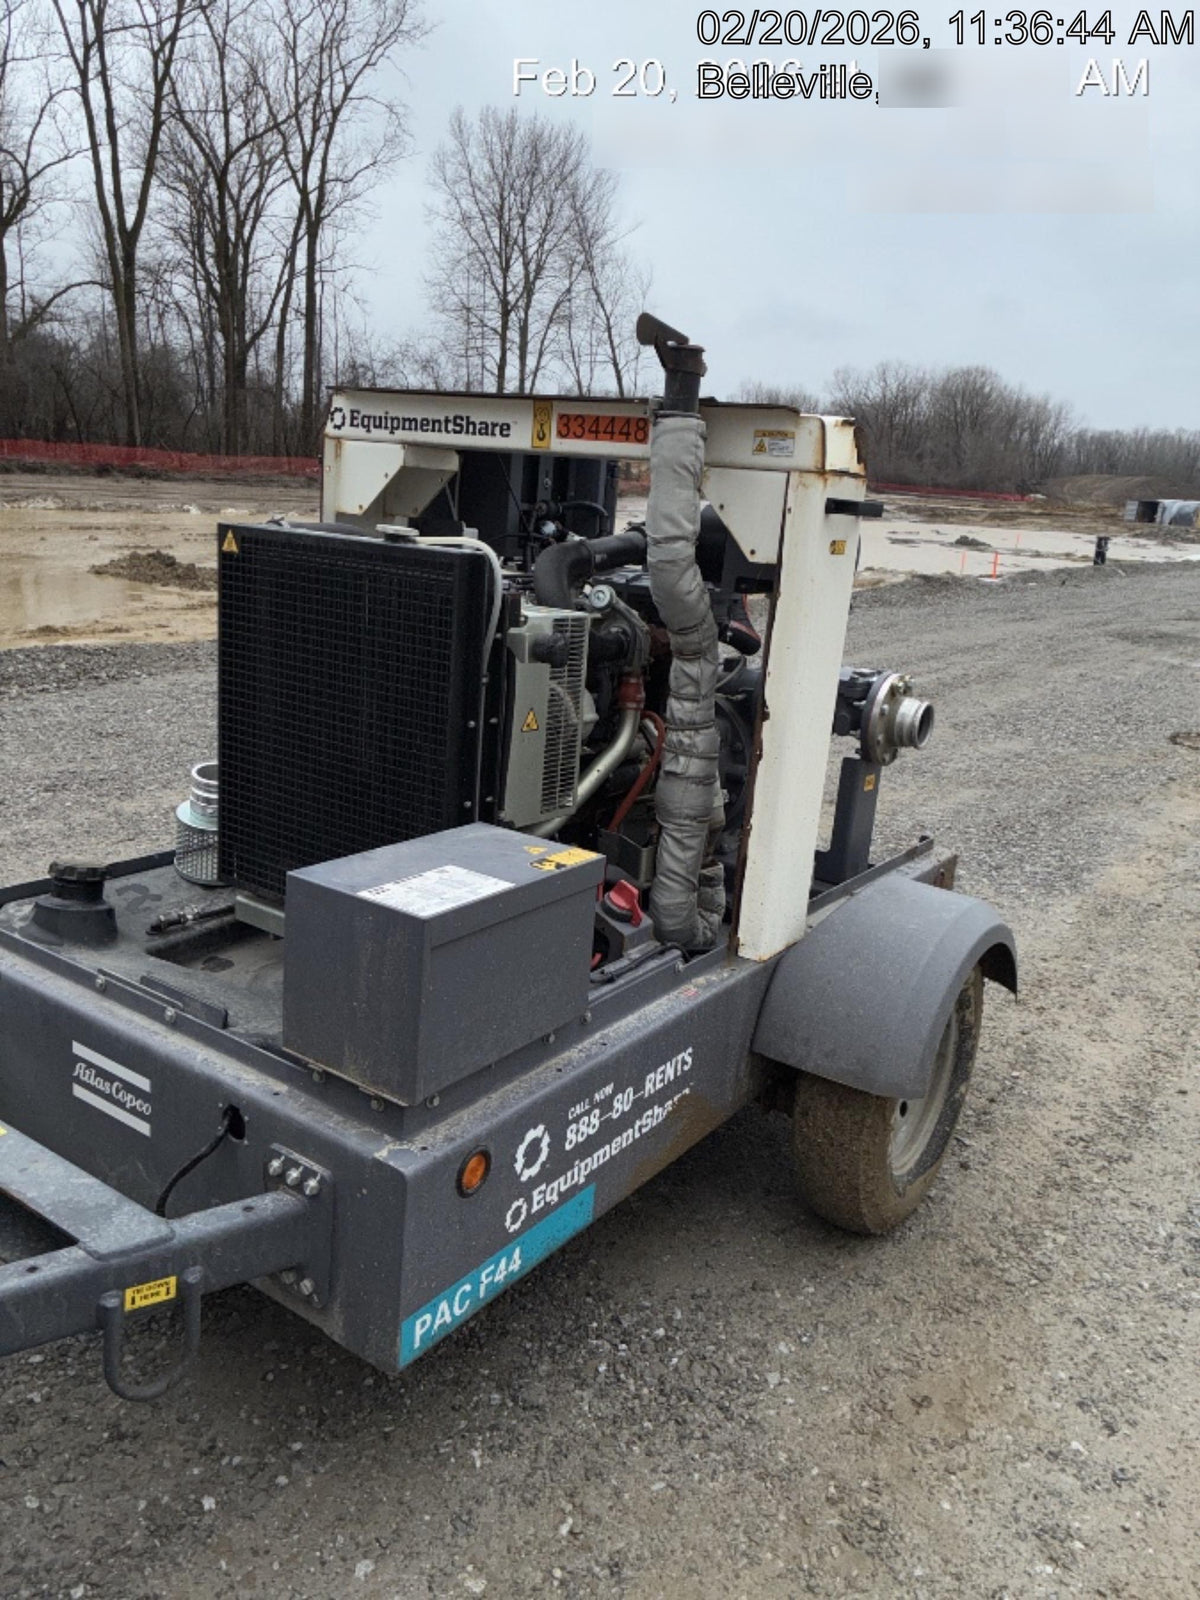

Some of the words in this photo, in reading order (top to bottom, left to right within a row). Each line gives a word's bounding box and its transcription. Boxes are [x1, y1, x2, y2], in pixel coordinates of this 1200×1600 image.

[349, 408, 512, 439] EquipmentShare
[557, 413, 649, 442] 334448
[72, 1061, 111, 1095] Atlas
[111, 1080, 152, 1116] Copco
[564, 1046, 693, 1151] 888-80-RENTS
[568, 1098, 590, 1120] CALL
[593, 1082, 615, 1103] NOW
[412, 1282, 472, 1349] PAC
[479, 1246, 522, 1298] F44
